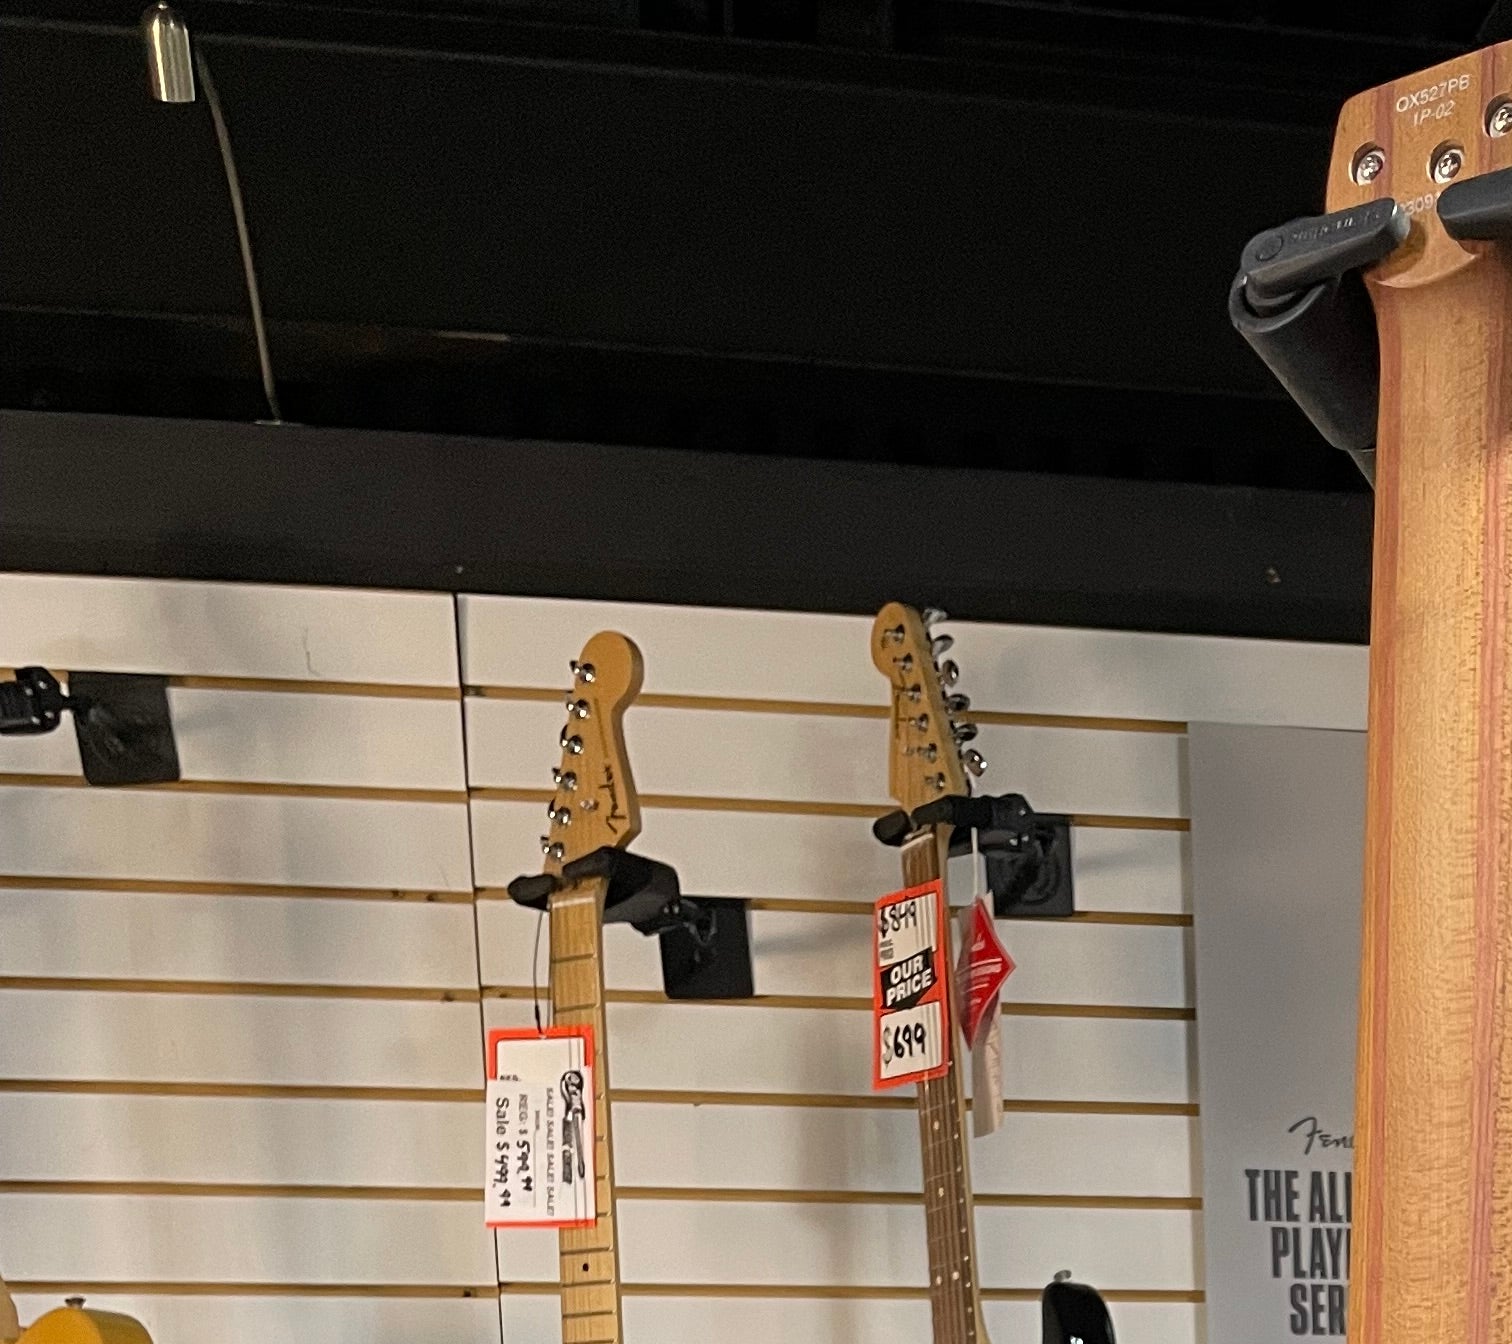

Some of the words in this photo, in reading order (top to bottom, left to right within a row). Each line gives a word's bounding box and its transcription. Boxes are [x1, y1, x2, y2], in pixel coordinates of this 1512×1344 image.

[886, 968, 934, 1008] PRICE
[889, 955, 924, 986] OUR
[882, 1023, 926, 1067] $699
[496, 1097, 510, 1136] Sale
[1245, 1168, 1300, 1222] THE
[1309, 1170, 1352, 1223] AL
[1270, 1226, 1351, 1280] PLAY
